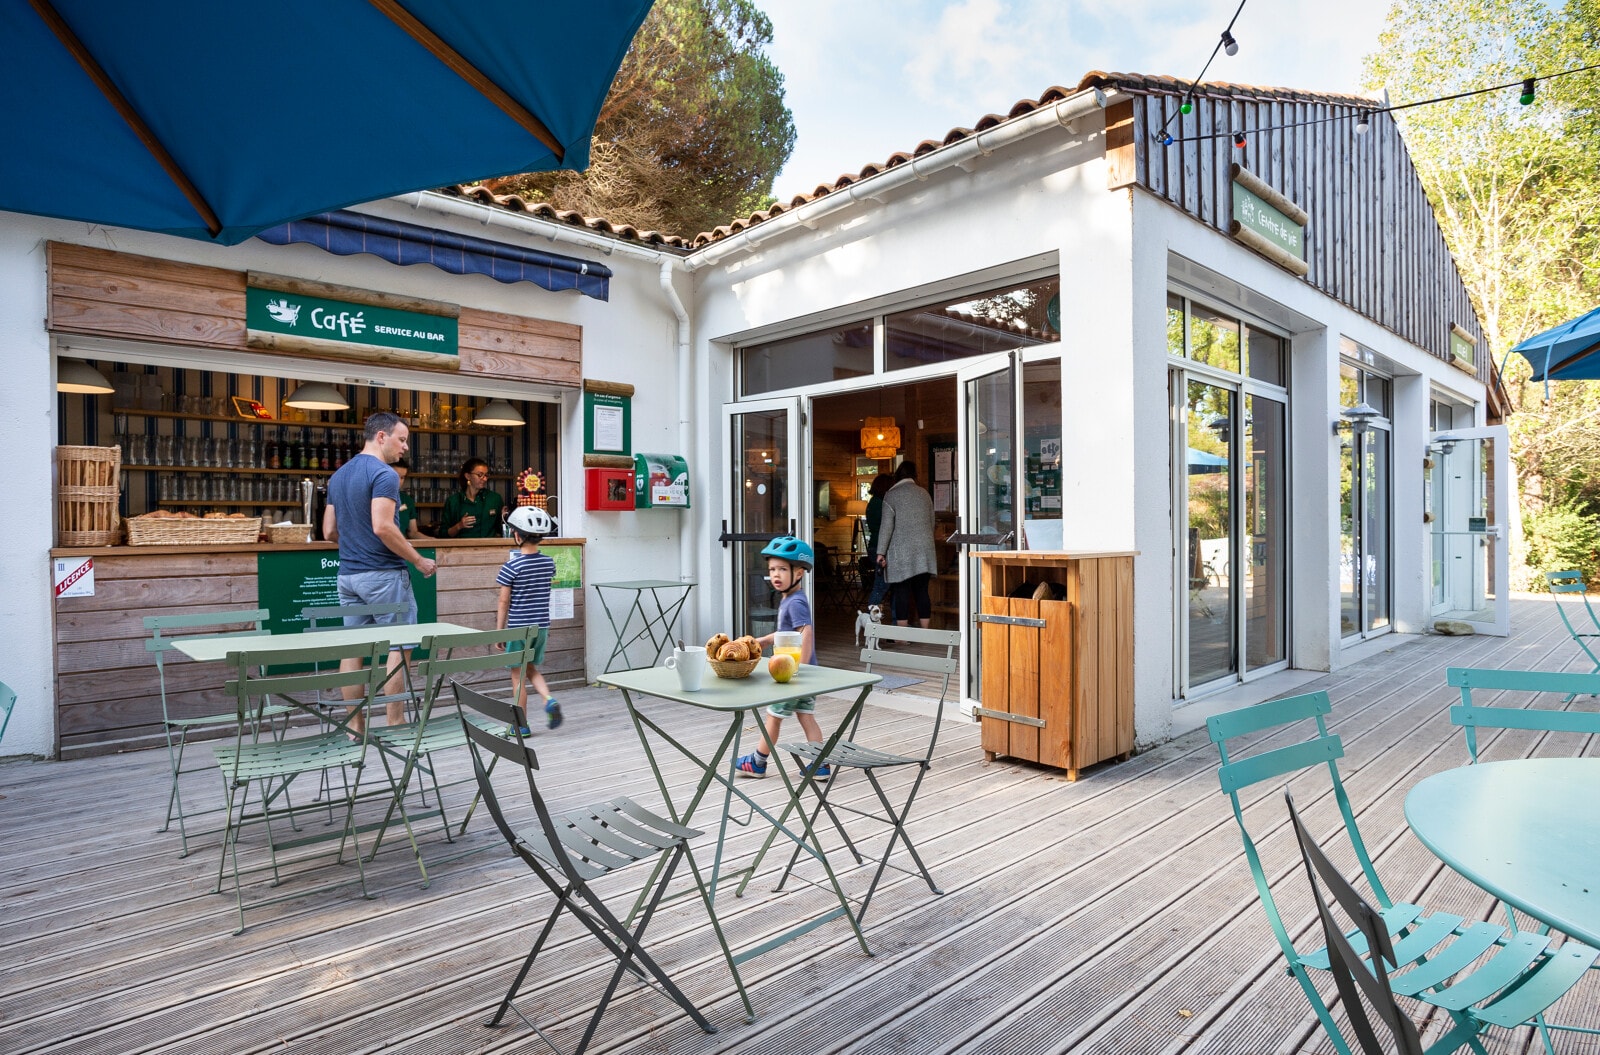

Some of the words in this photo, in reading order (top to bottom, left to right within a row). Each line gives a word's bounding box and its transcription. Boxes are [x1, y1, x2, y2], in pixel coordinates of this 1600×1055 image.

[374, 325, 412, 337] SERVICE
[413, 330, 426, 339] AU
[426, 332, 445, 342] BAR
[59, 560, 91, 593] LICENCE
